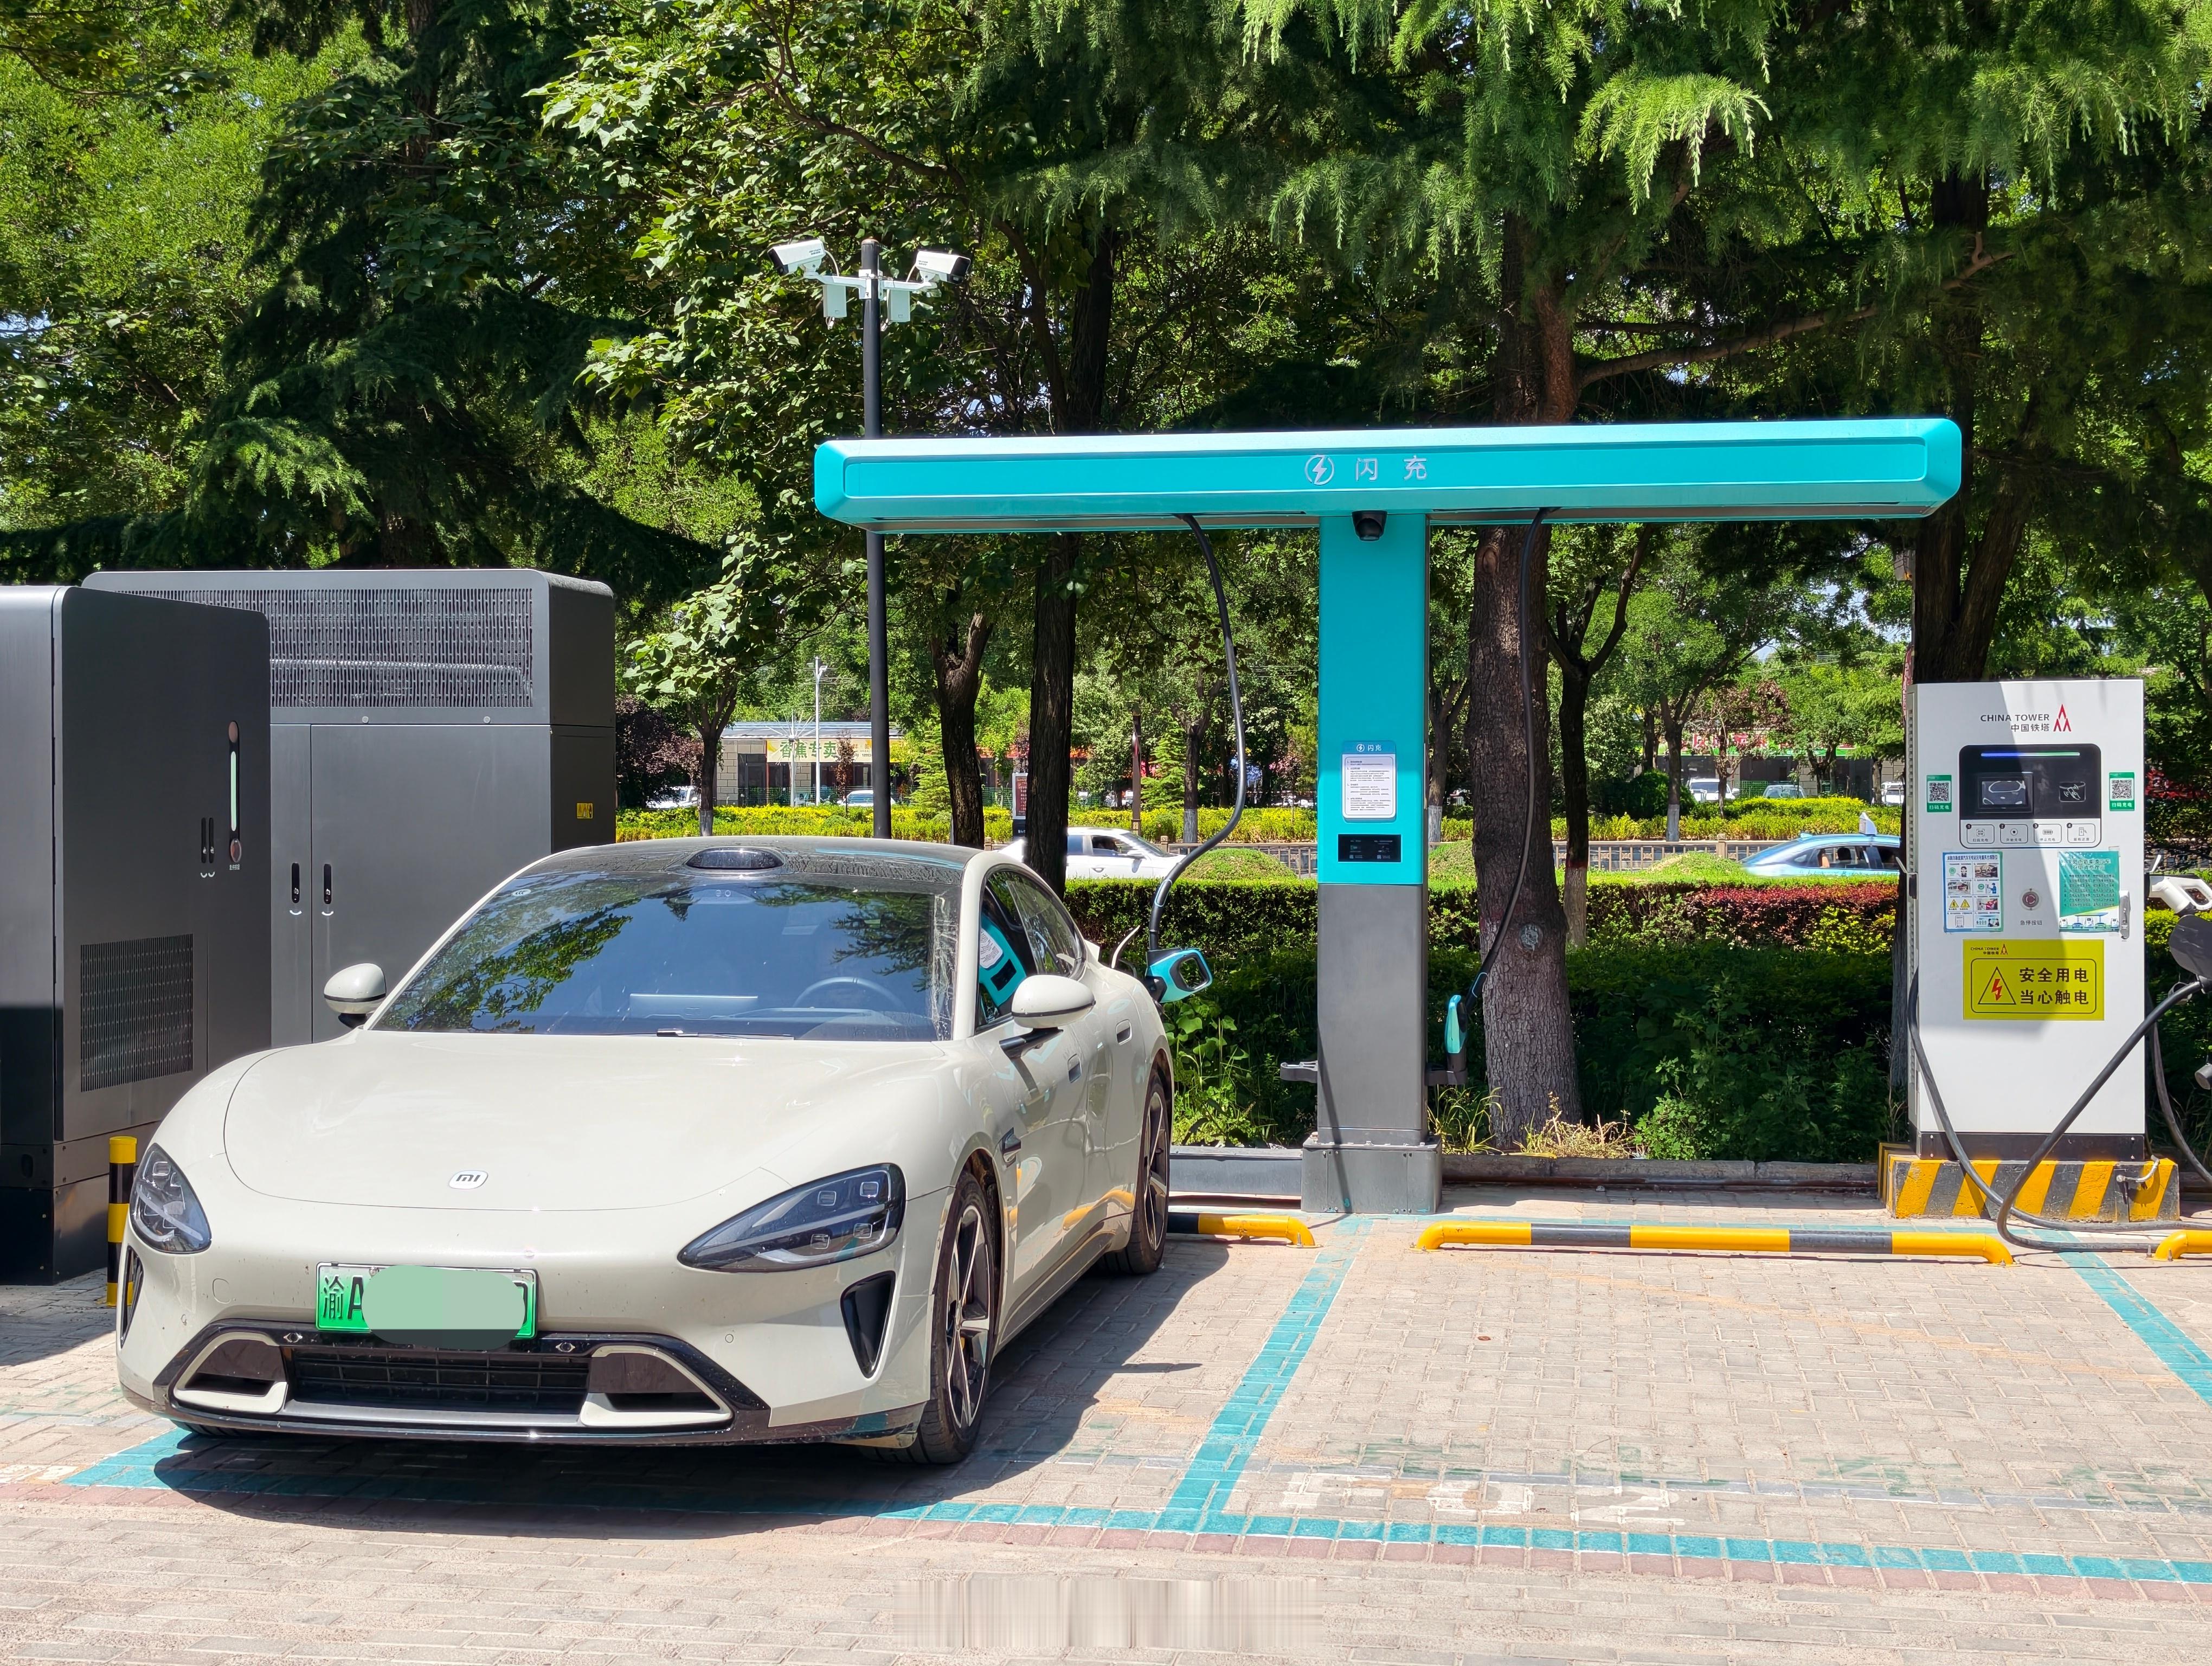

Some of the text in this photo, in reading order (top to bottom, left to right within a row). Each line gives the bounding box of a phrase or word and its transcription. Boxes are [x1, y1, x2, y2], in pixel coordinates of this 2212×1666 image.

[1356, 455, 1427, 482] 闪充
[2015, 713, 2050, 721] TOWER
[2011, 723, 2050, 733] 中国铁塔
[780, 741, 837, 759] 香蕉专卖
[2019, 967, 2088, 983] 安全用电
[2020, 989, 2089, 1004] 当心触电
